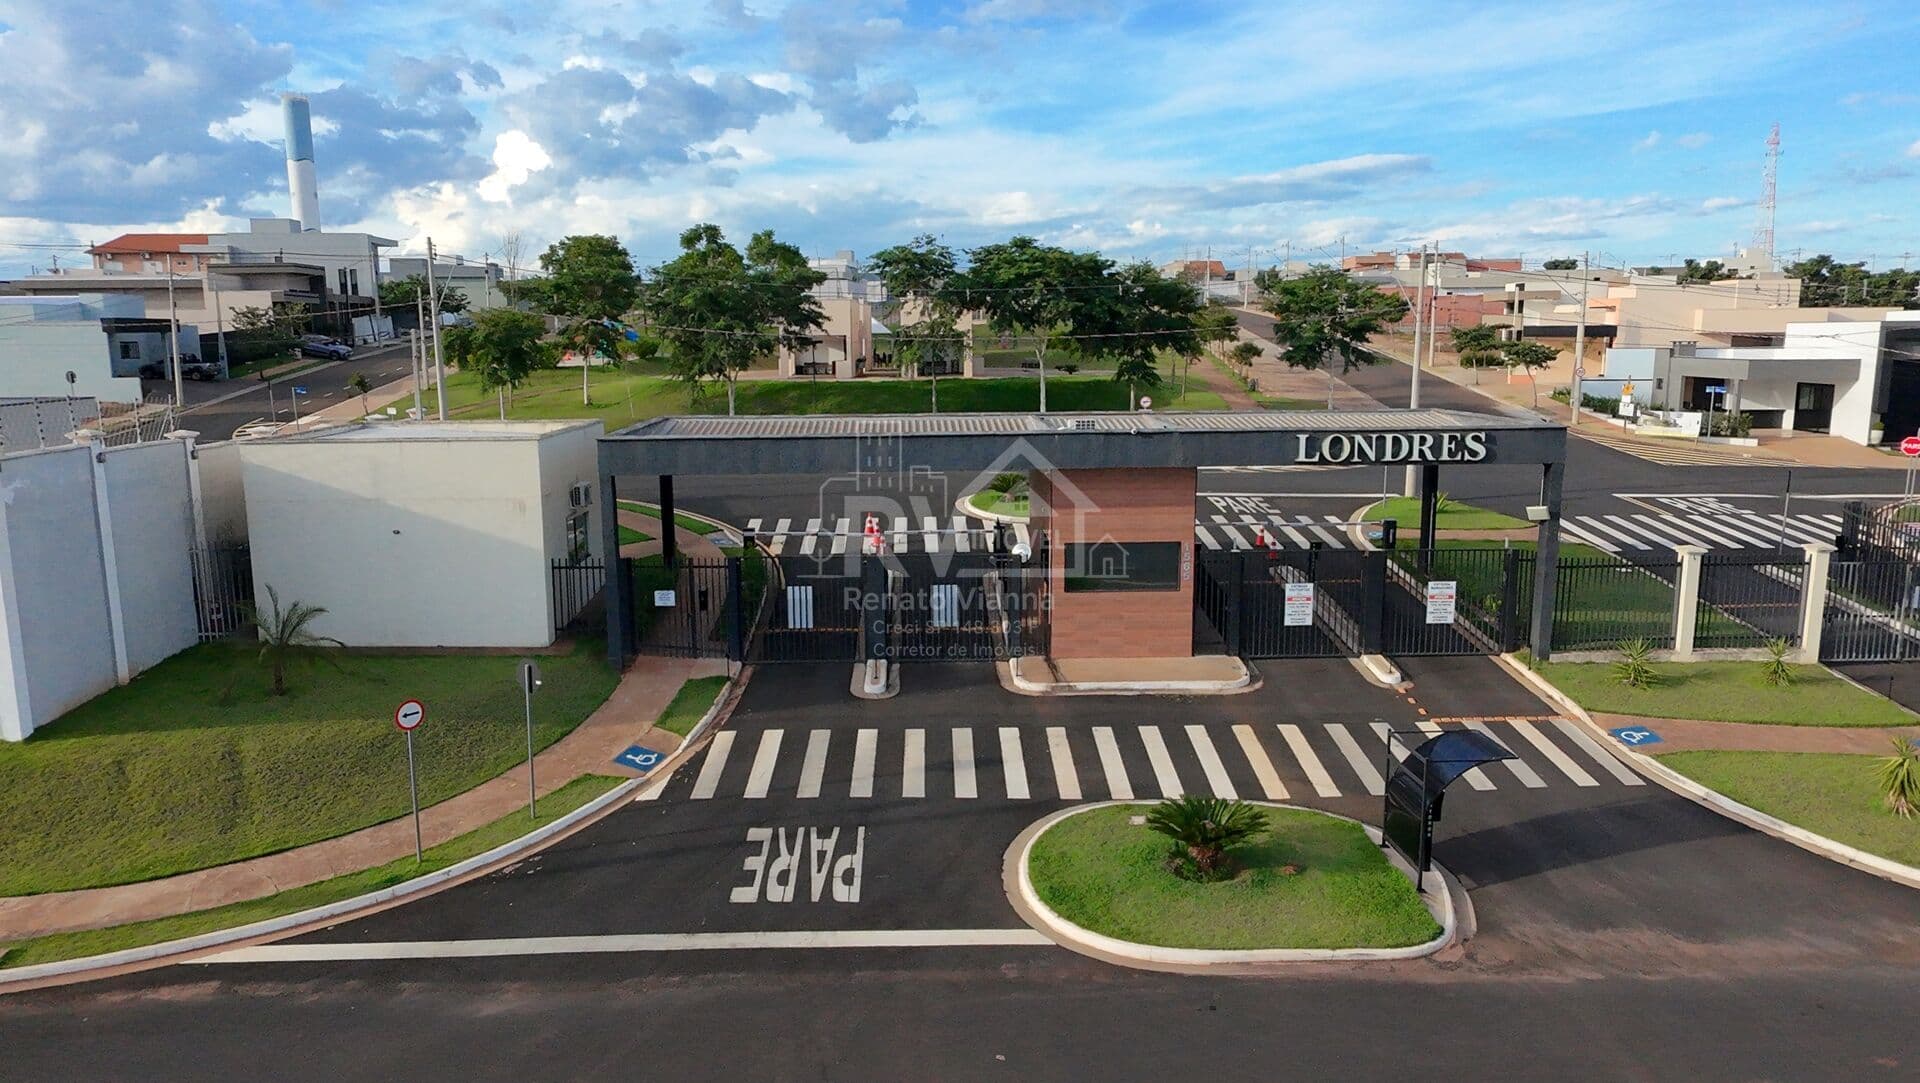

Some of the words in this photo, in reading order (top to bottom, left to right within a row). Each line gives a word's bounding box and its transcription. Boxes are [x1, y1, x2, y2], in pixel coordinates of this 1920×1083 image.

[1294, 431, 1488, 463] LONDRES
[1207, 496, 1282, 514] PARE
[729, 826, 866, 903] PARE
